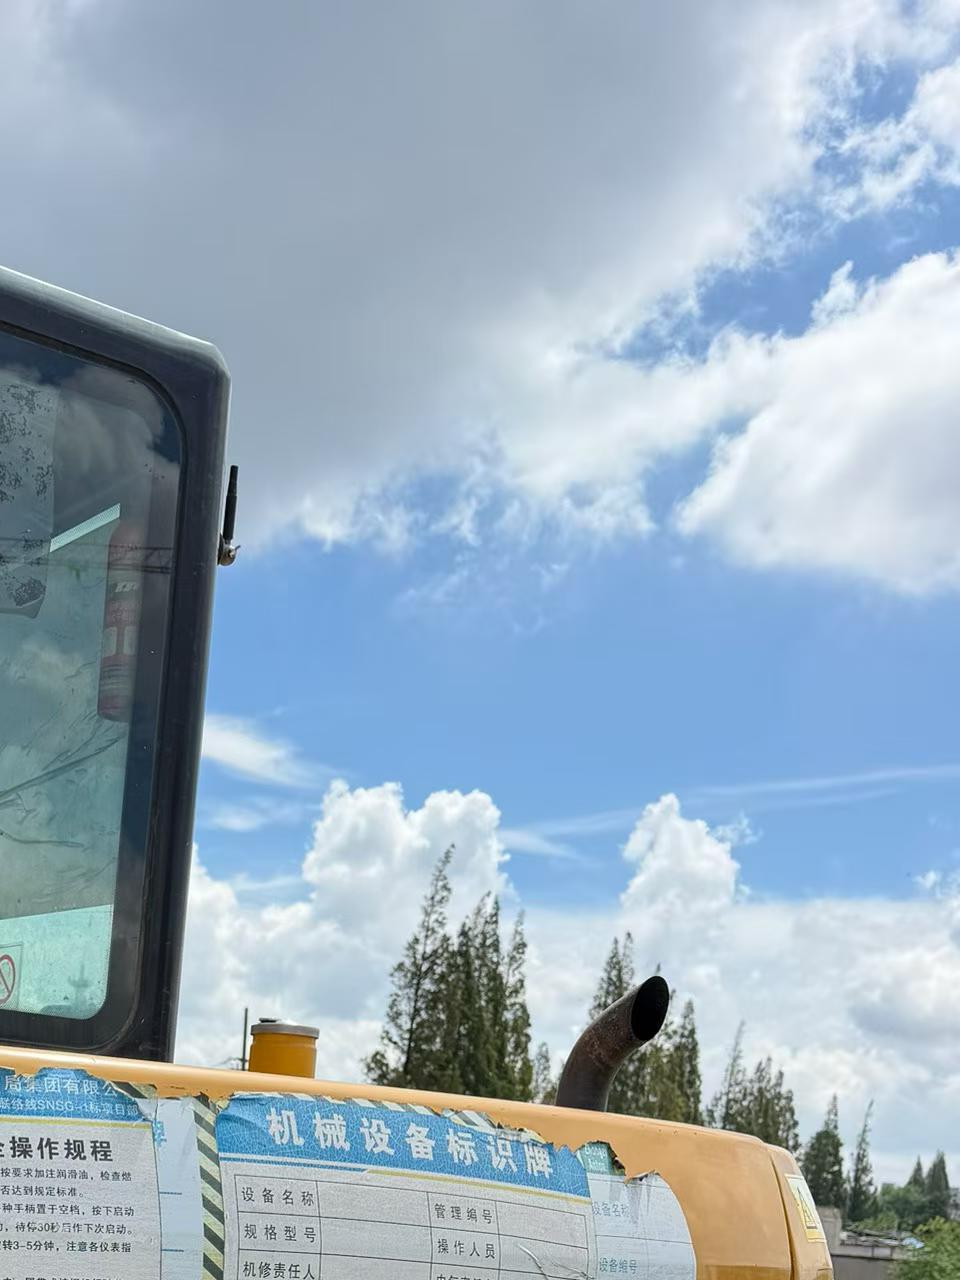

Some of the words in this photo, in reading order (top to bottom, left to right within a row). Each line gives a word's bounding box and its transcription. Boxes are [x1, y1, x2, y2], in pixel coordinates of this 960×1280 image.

[265, 1106, 554, 1180] 机械设备标识牌
[241, 1186, 315, 1207] 设备名称
[434, 1202, 493, 1225] 管理编号
[243, 1222, 317, 1244] 规格型号
[437, 1238, 496, 1260] 操作人员
[242, 1260, 316, 1280] 机修责任人
[598, 1256, 639, 1276] 设备编号
